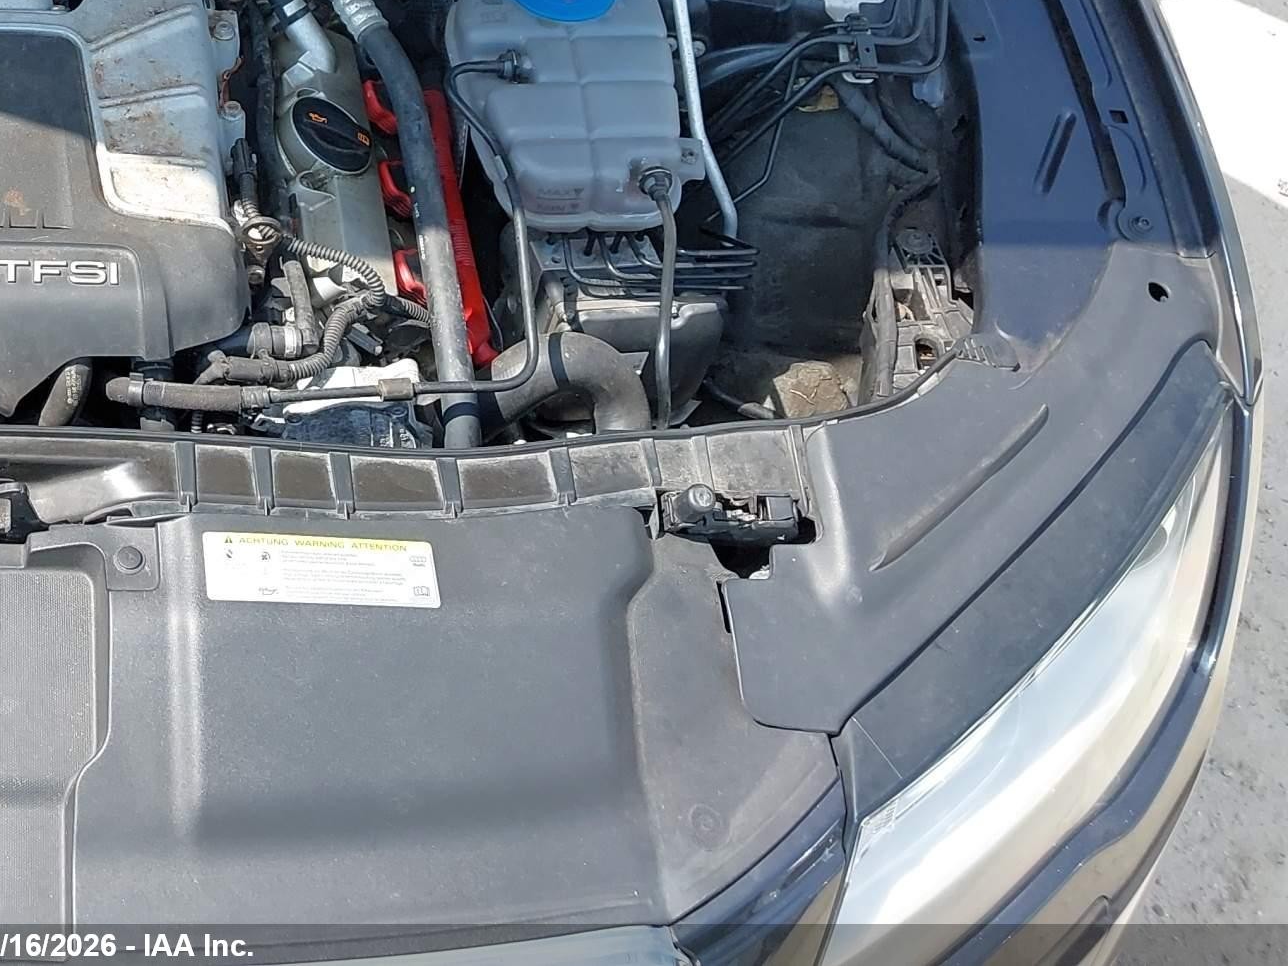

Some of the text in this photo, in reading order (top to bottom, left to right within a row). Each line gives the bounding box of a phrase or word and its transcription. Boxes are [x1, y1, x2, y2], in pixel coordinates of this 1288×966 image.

[239, 537, 407, 551] ACHTUNG WARNING ATTENTION
